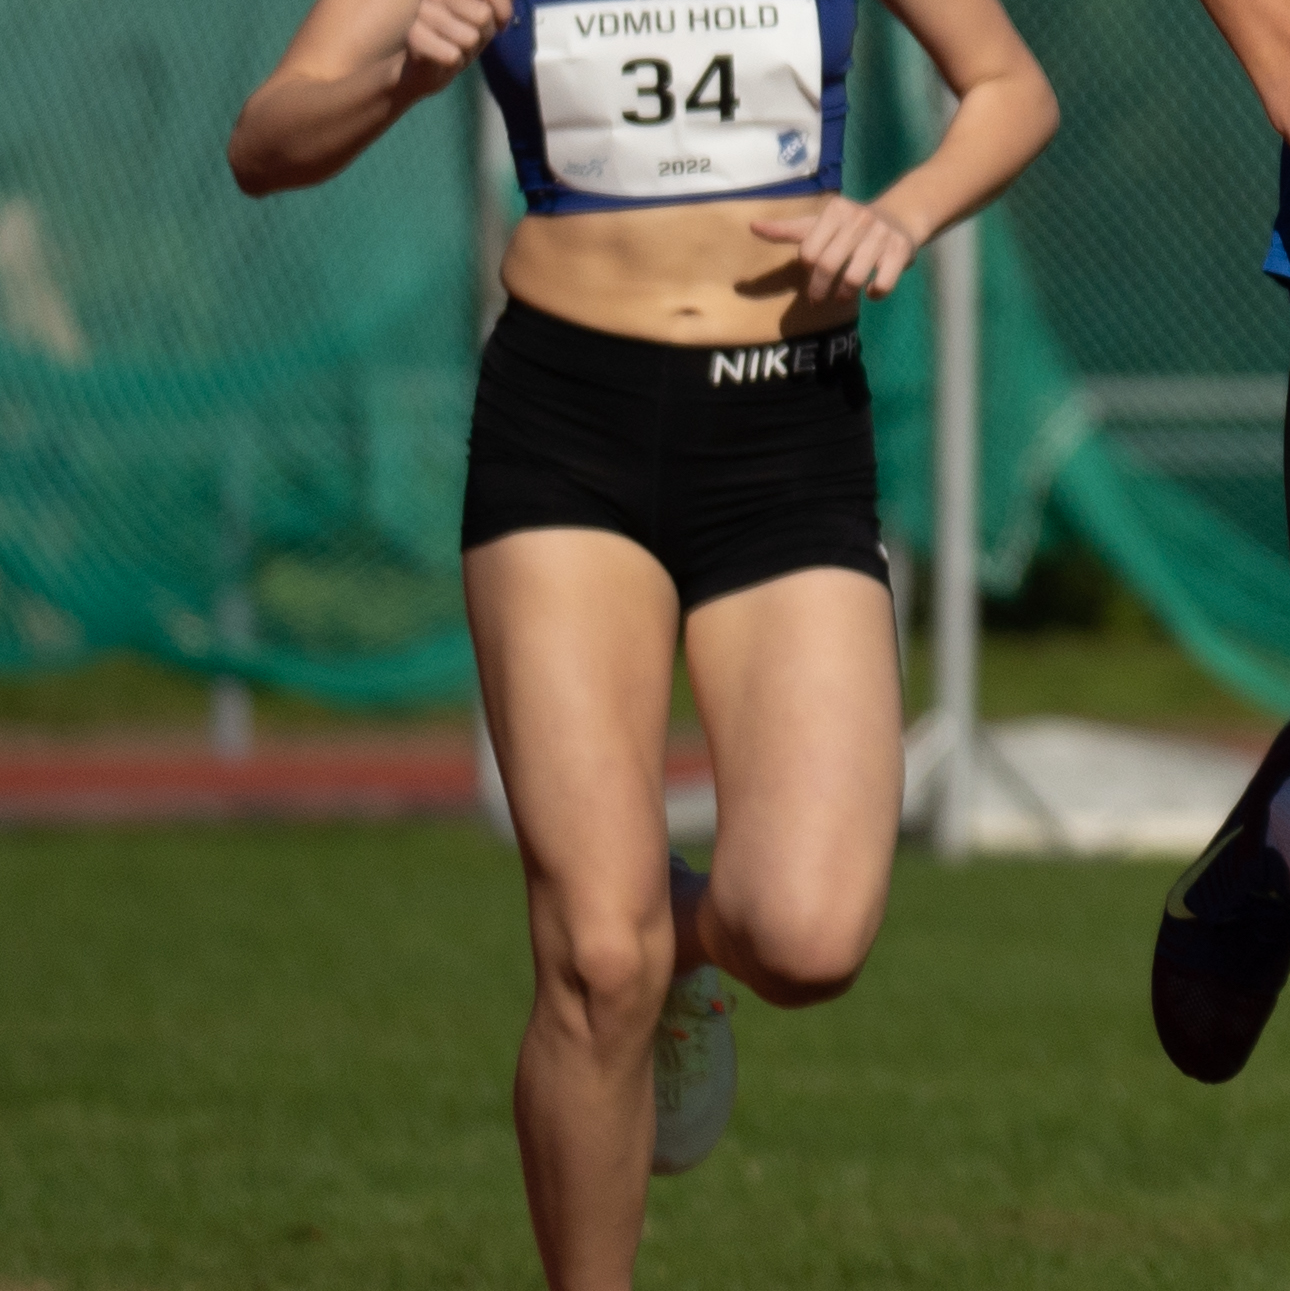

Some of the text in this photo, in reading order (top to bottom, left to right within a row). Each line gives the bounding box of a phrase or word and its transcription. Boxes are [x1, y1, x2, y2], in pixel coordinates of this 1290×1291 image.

[575, 3, 779, 39] VDMU HOLD
[620, 53, 741, 128] 34
[659, 158, 712, 178] 2022
[708, 342, 819, 388] NIKE
